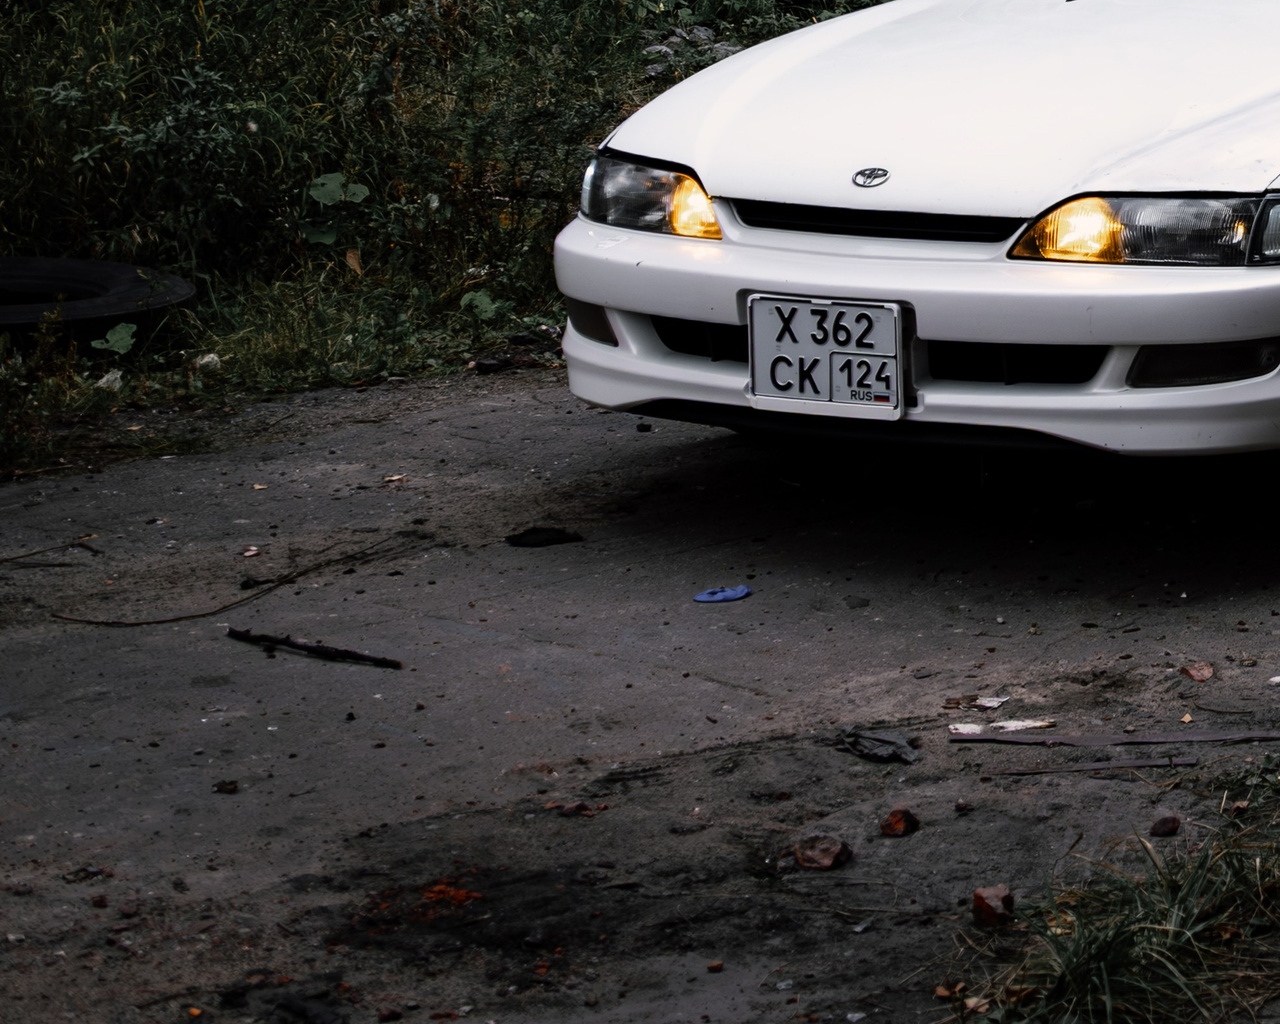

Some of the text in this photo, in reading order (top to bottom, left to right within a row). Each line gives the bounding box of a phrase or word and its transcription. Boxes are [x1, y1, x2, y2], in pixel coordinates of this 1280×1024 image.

[810, 308, 875, 349] 362
[770, 354, 821, 395] CK
[839, 358, 891, 390] 124
[850, 389, 873, 402] RUS
